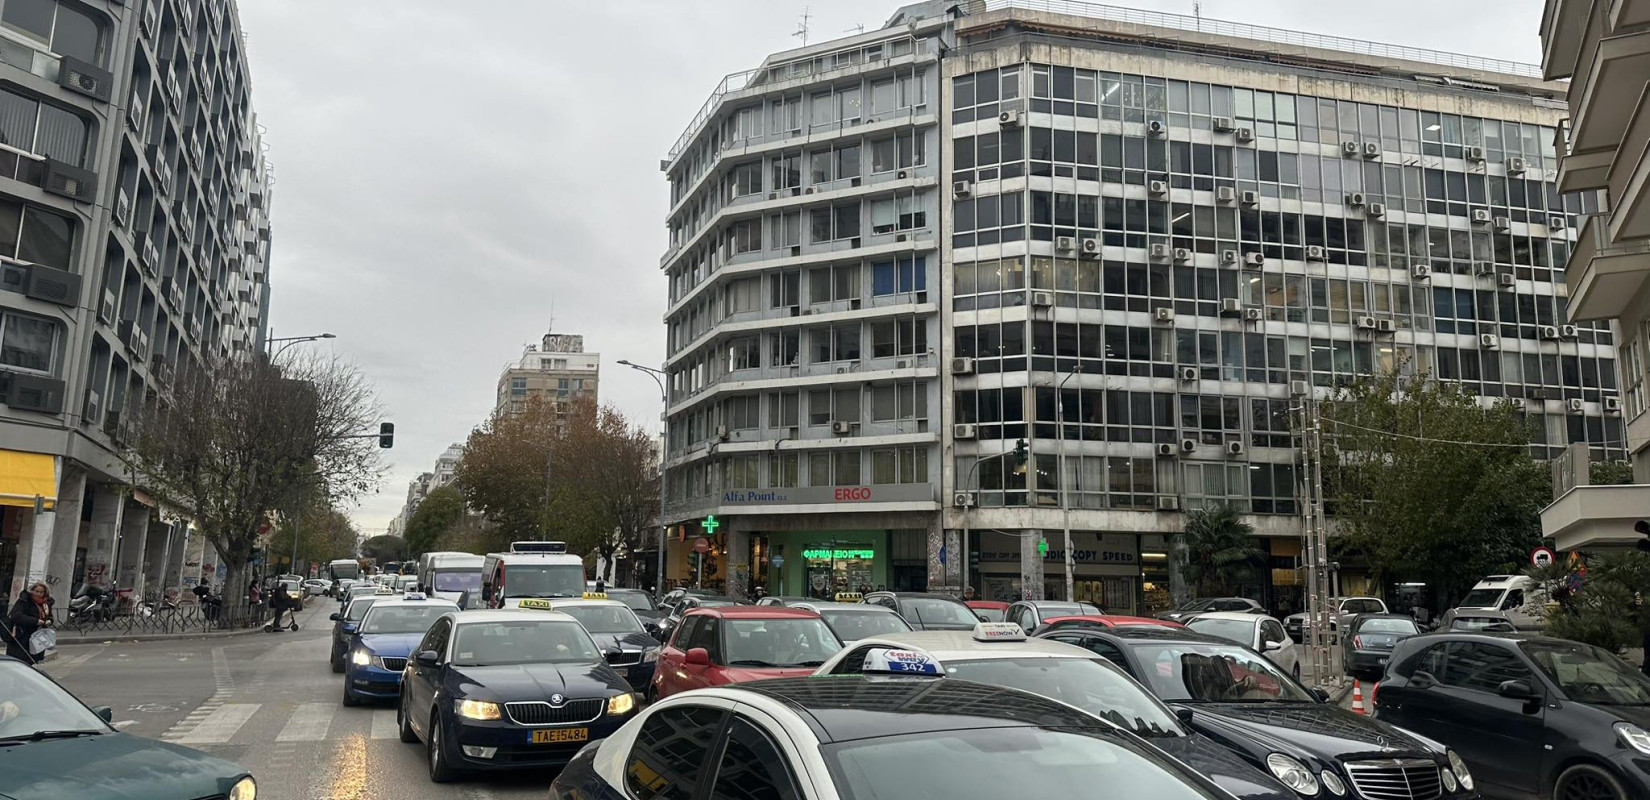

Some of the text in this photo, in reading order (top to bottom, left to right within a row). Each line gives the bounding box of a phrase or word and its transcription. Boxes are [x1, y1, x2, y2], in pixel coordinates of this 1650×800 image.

[723, 490, 745, 502] Alfa
[747, 491, 775, 502] Point
[834, 487, 871, 501] ERGO
[1072, 550, 1097, 561] COPY
[1103, 551, 1133, 561] SPEED
[524, 600, 549, 608] TAXI
[901, 662, 926, 671] 342
